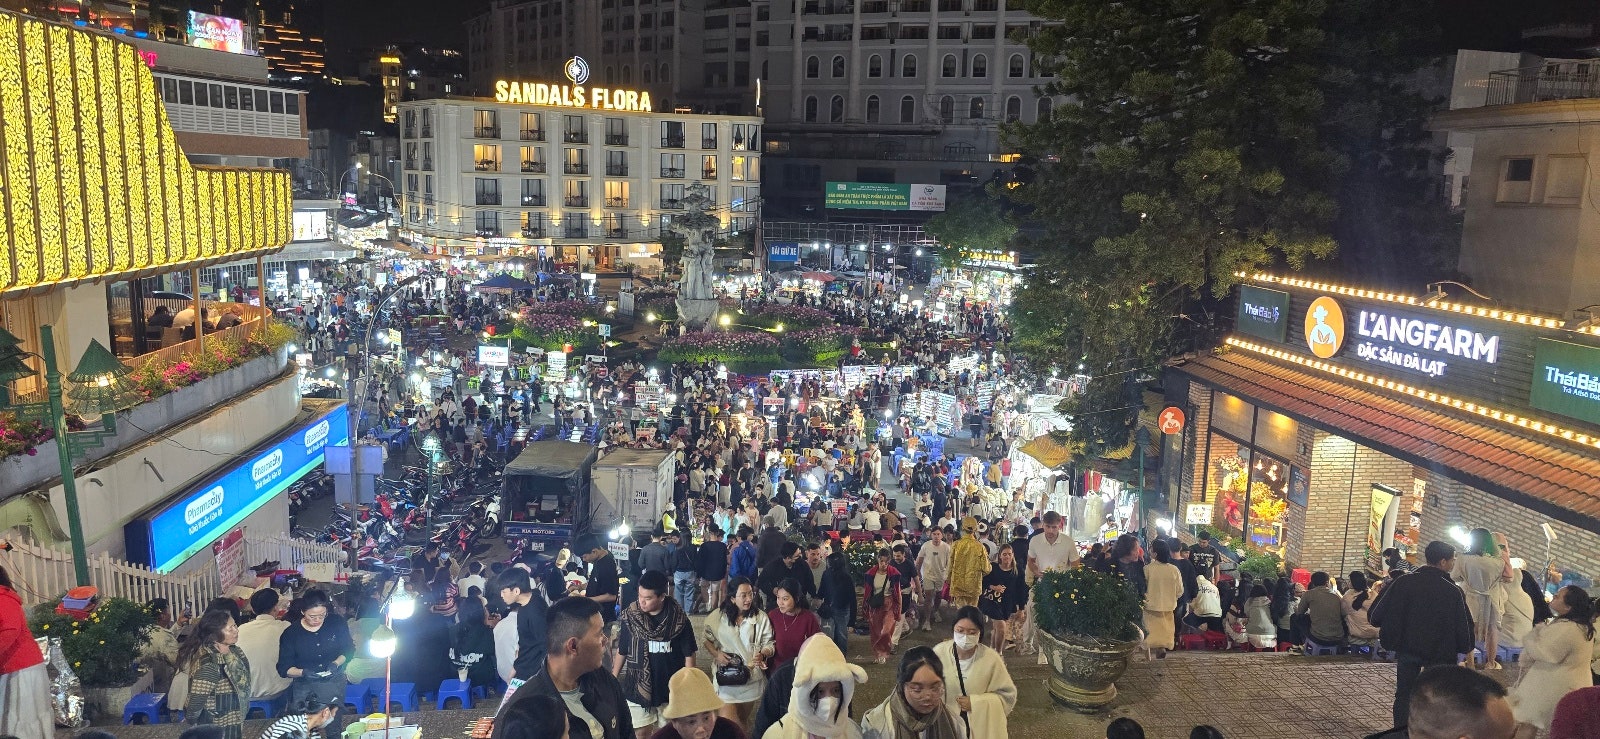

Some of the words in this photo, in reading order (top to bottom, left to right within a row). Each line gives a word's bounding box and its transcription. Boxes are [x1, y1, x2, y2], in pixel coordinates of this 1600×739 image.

[495, 80, 586, 107] SANDALS
[591, 87, 652, 113] FLORA
[1358, 342, 1378, 360] ĐẶC
[1380, 346, 1400, 366] SẢN
[1404, 352, 1420, 370] ĐÀ
[1422, 358, 1448, 378] LẠT
[188, 491, 222, 522] Pharmacity
